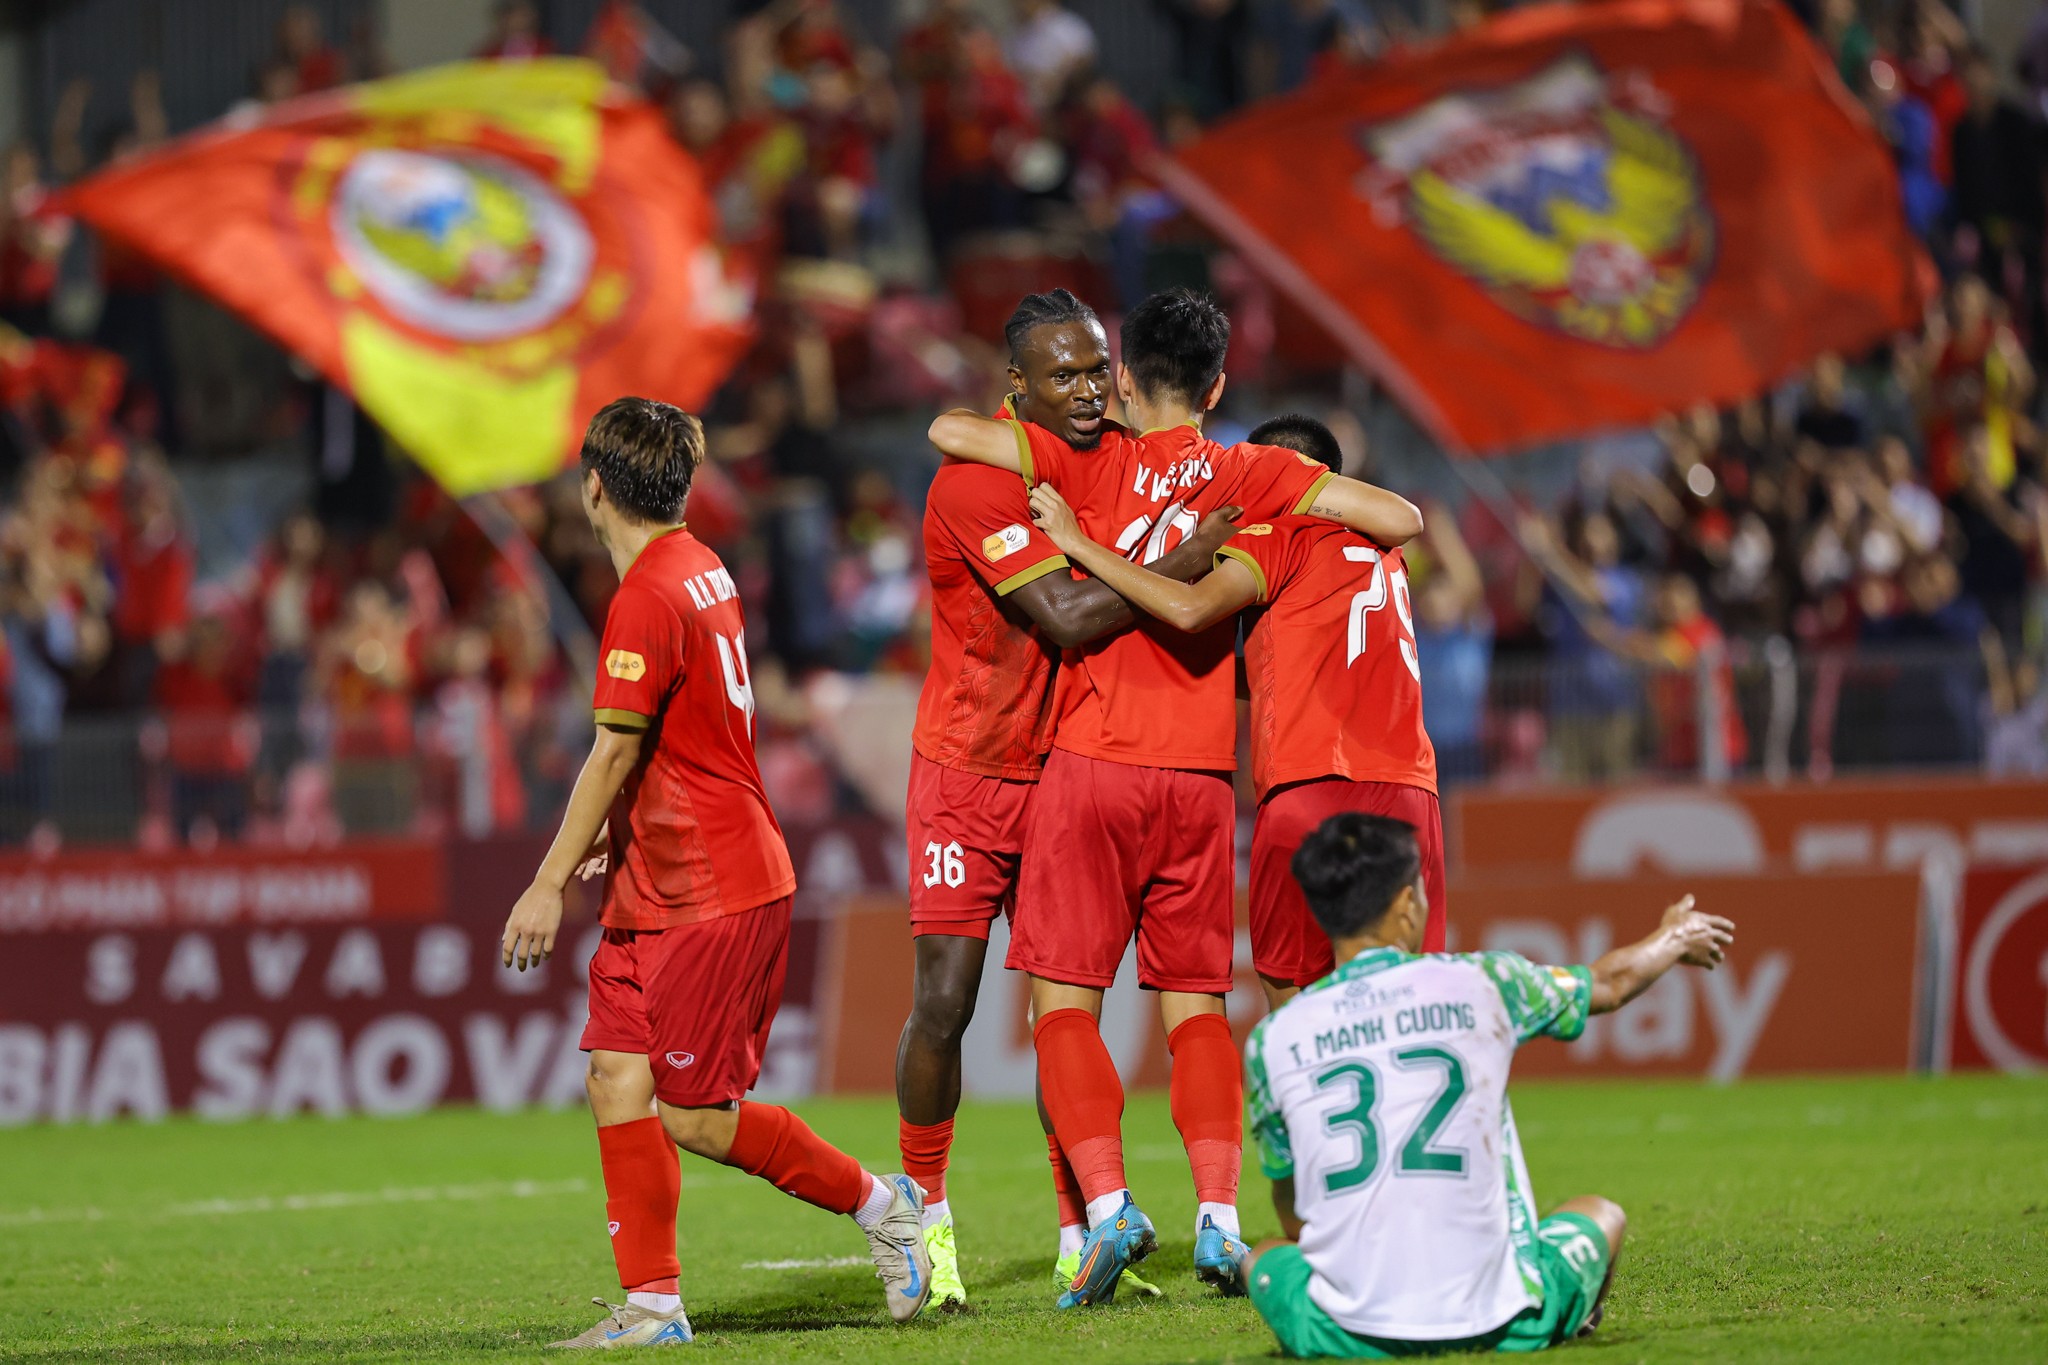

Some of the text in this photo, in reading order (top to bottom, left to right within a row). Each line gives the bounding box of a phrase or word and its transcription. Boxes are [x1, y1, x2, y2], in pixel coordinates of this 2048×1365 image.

[1343, 546, 1421, 686] 79
[716, 625, 755, 742] 4
[923, 840, 966, 889] 36
[0, 1020, 170, 1125] BIA
[190, 1015, 451, 1117] SAO
[1314, 1015, 1386, 1060] MANH
[1396, 1001, 1477, 1037] CUONG
[1310, 1040, 1472, 1200] 32
